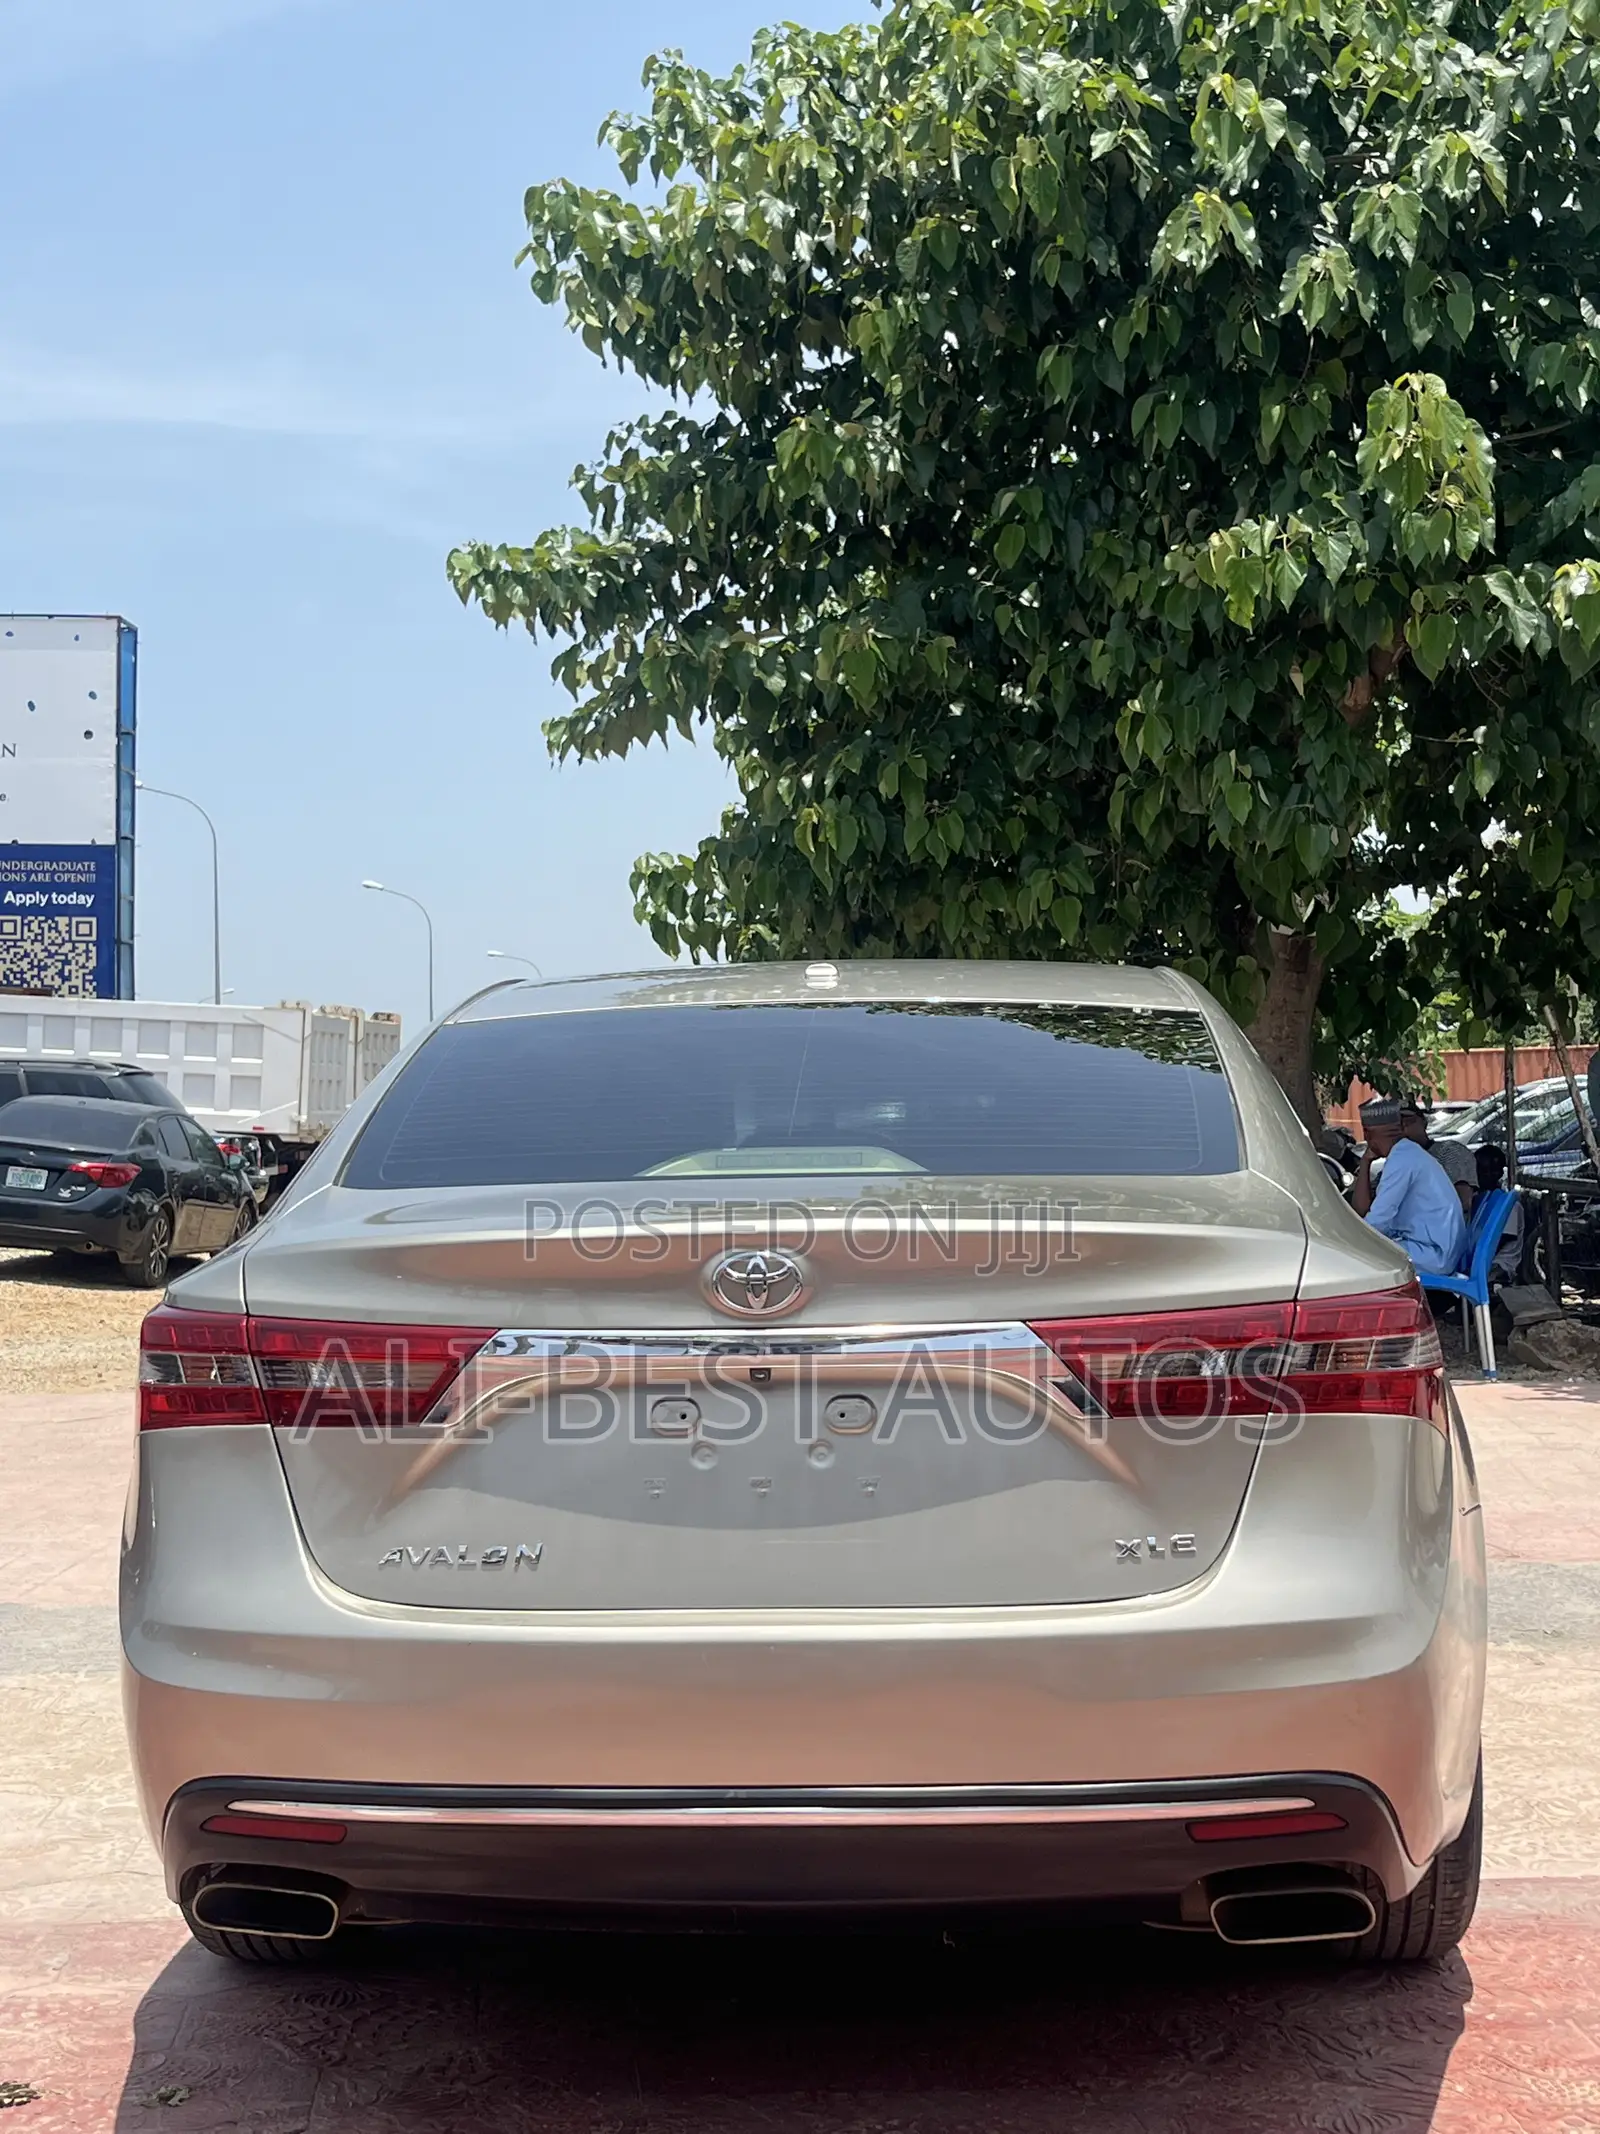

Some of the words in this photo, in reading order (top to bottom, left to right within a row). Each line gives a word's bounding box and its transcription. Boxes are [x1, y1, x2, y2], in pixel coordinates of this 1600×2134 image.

[0, 860, 96, 871] NDERGRADUATE
[29, 872, 51, 882] ARE
[54, 872, 96, 883] OPEN!!!
[3, 890, 49, 907] Apply
[51, 891, 95, 908] today
[378, 1540, 544, 1568] AVALON
[1115, 1533, 1197, 1560] XLE
